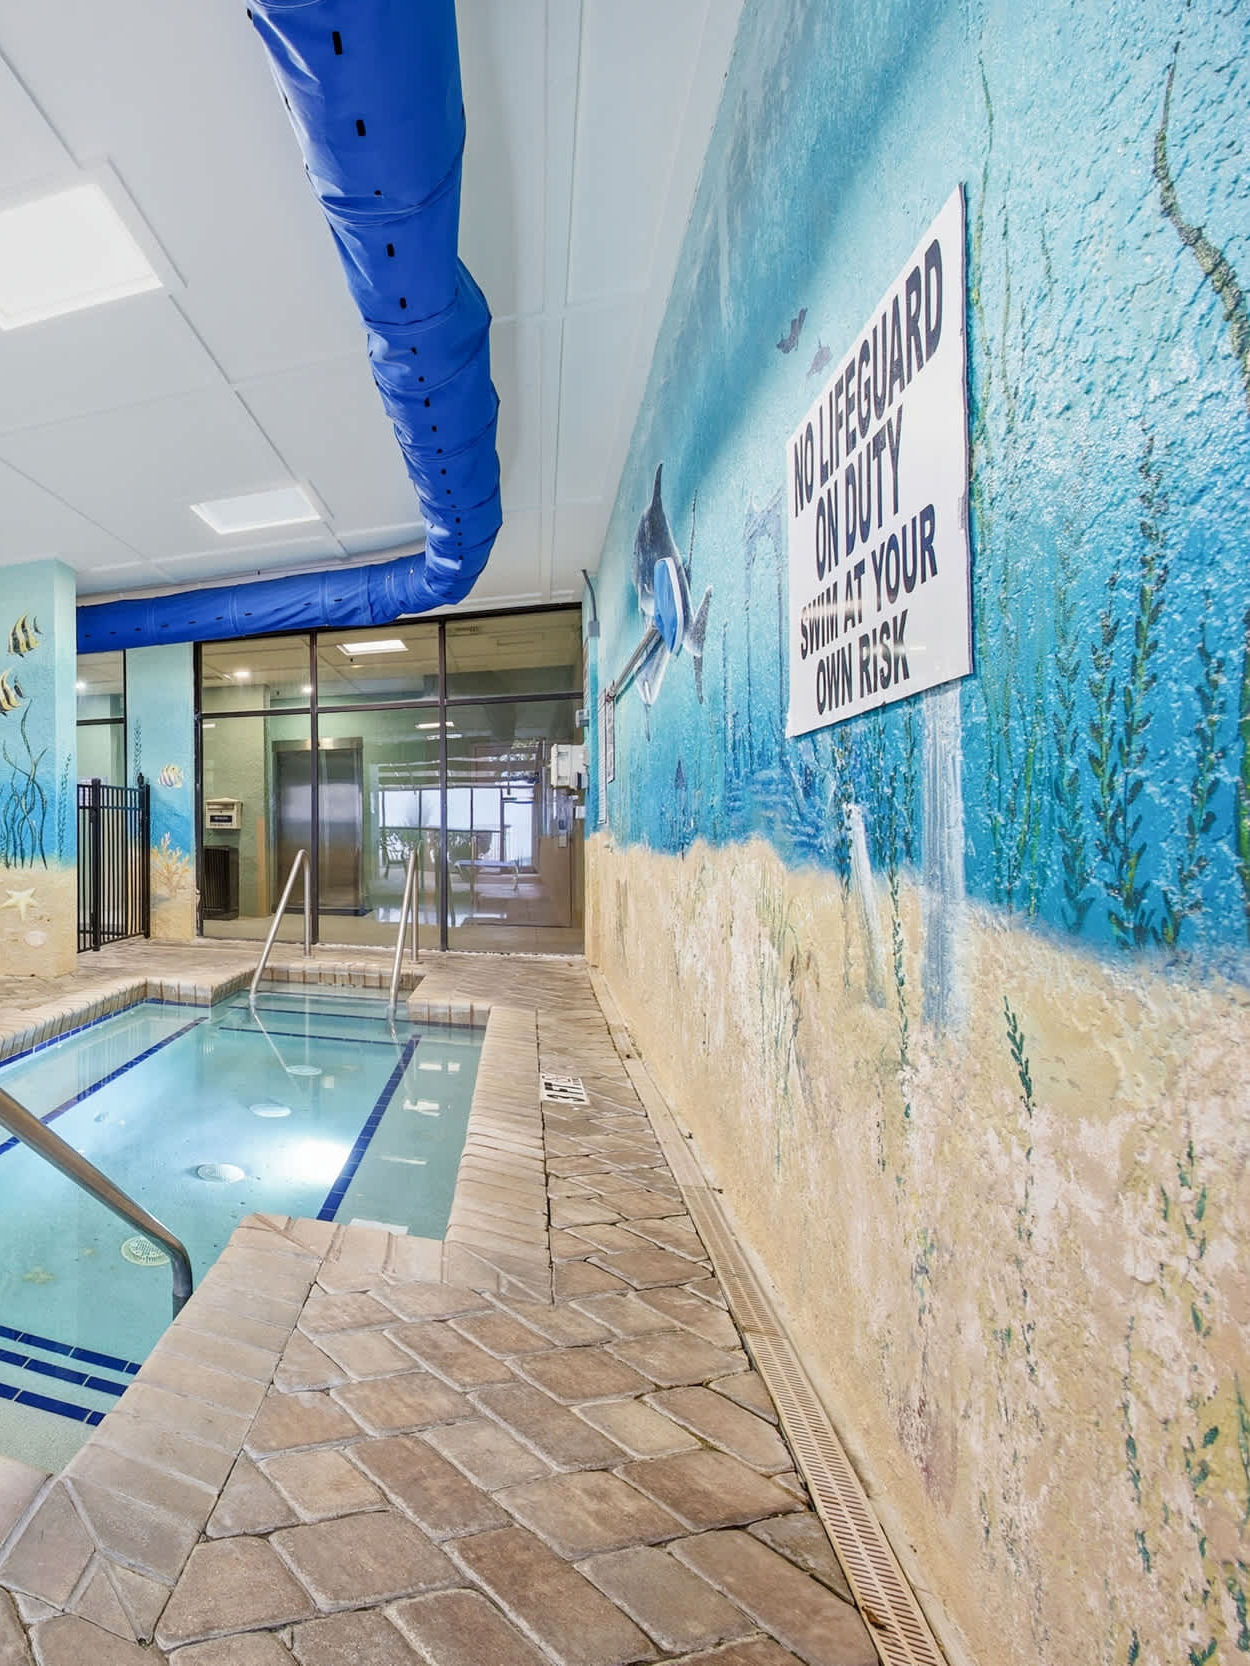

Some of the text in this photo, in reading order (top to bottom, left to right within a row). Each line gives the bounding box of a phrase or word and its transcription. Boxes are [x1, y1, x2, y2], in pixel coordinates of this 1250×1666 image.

[794, 239, 943, 518] NO LIFEGUARD
[815, 402, 903, 582] ON DUTY
[800, 503, 938, 660] SWIM AT YOUR
[816, 609, 910, 716] OWN RISK
